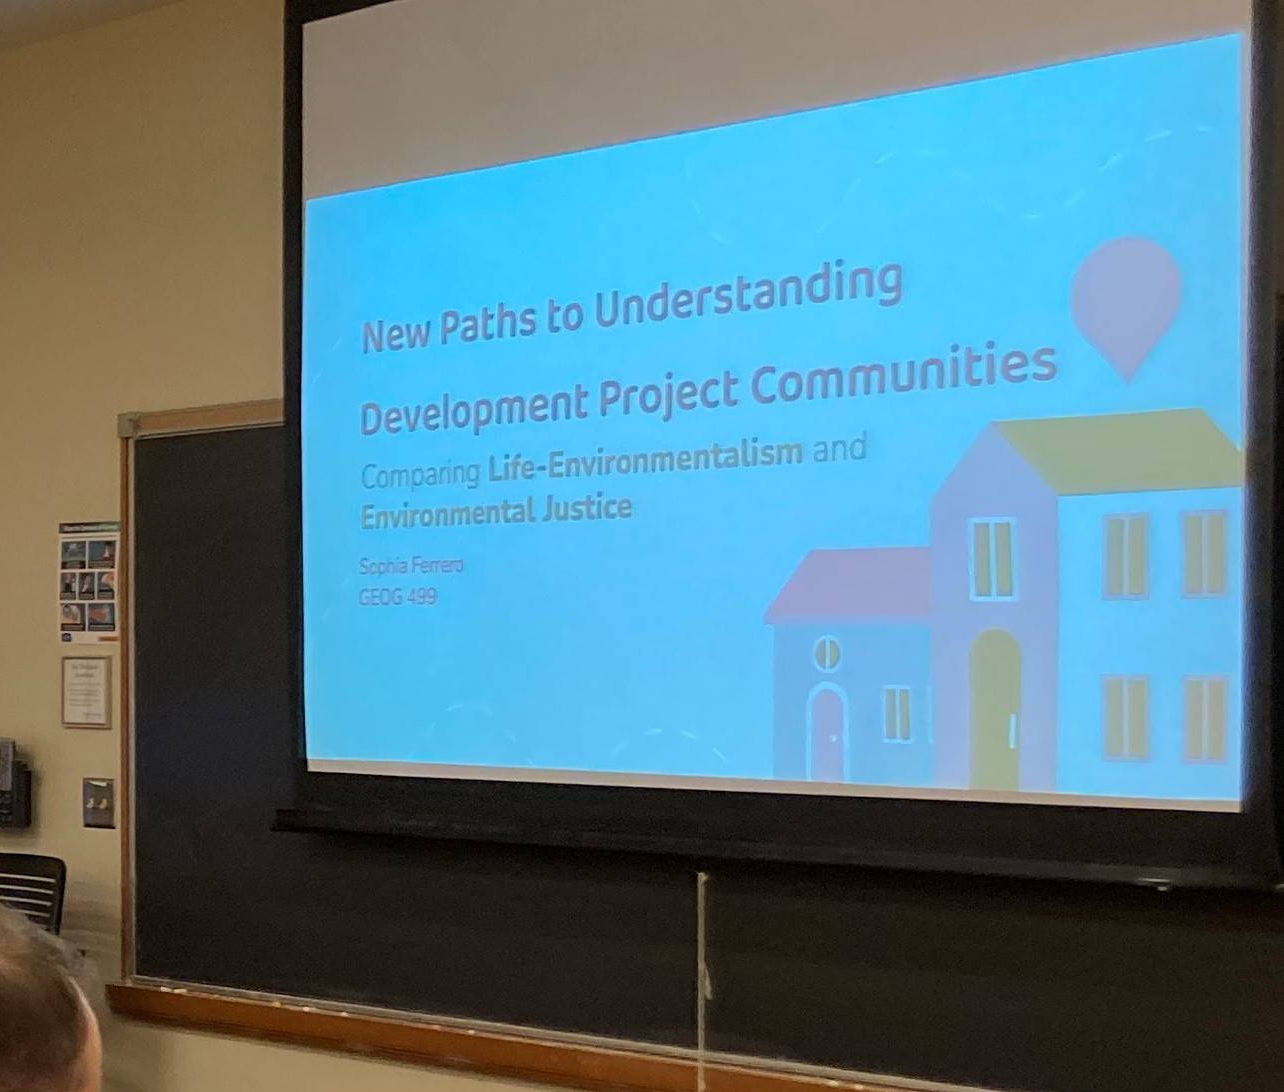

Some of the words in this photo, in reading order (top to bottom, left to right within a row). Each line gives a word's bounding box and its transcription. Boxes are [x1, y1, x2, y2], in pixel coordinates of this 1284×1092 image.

[362, 319, 431, 354] New
[440, 302, 537, 345] Paths
[547, 299, 583, 334] to
[595, 258, 903, 328] Understanding
[360, 392, 589, 436] Development
[599, 370, 738, 422] Project
[750, 340, 1058, 405] Communities
[361, 459, 480, 491] Comparing
[488, 437, 804, 482] Life-Environmentalism
[812, 430, 868, 463] and
[360, 497, 536, 530] Environmental
[542, 491, 634, 522] Justice
[358, 557, 409, 577] Sophia
[358, 588, 403, 606] GEOG
[407, 588, 436, 605] 499
